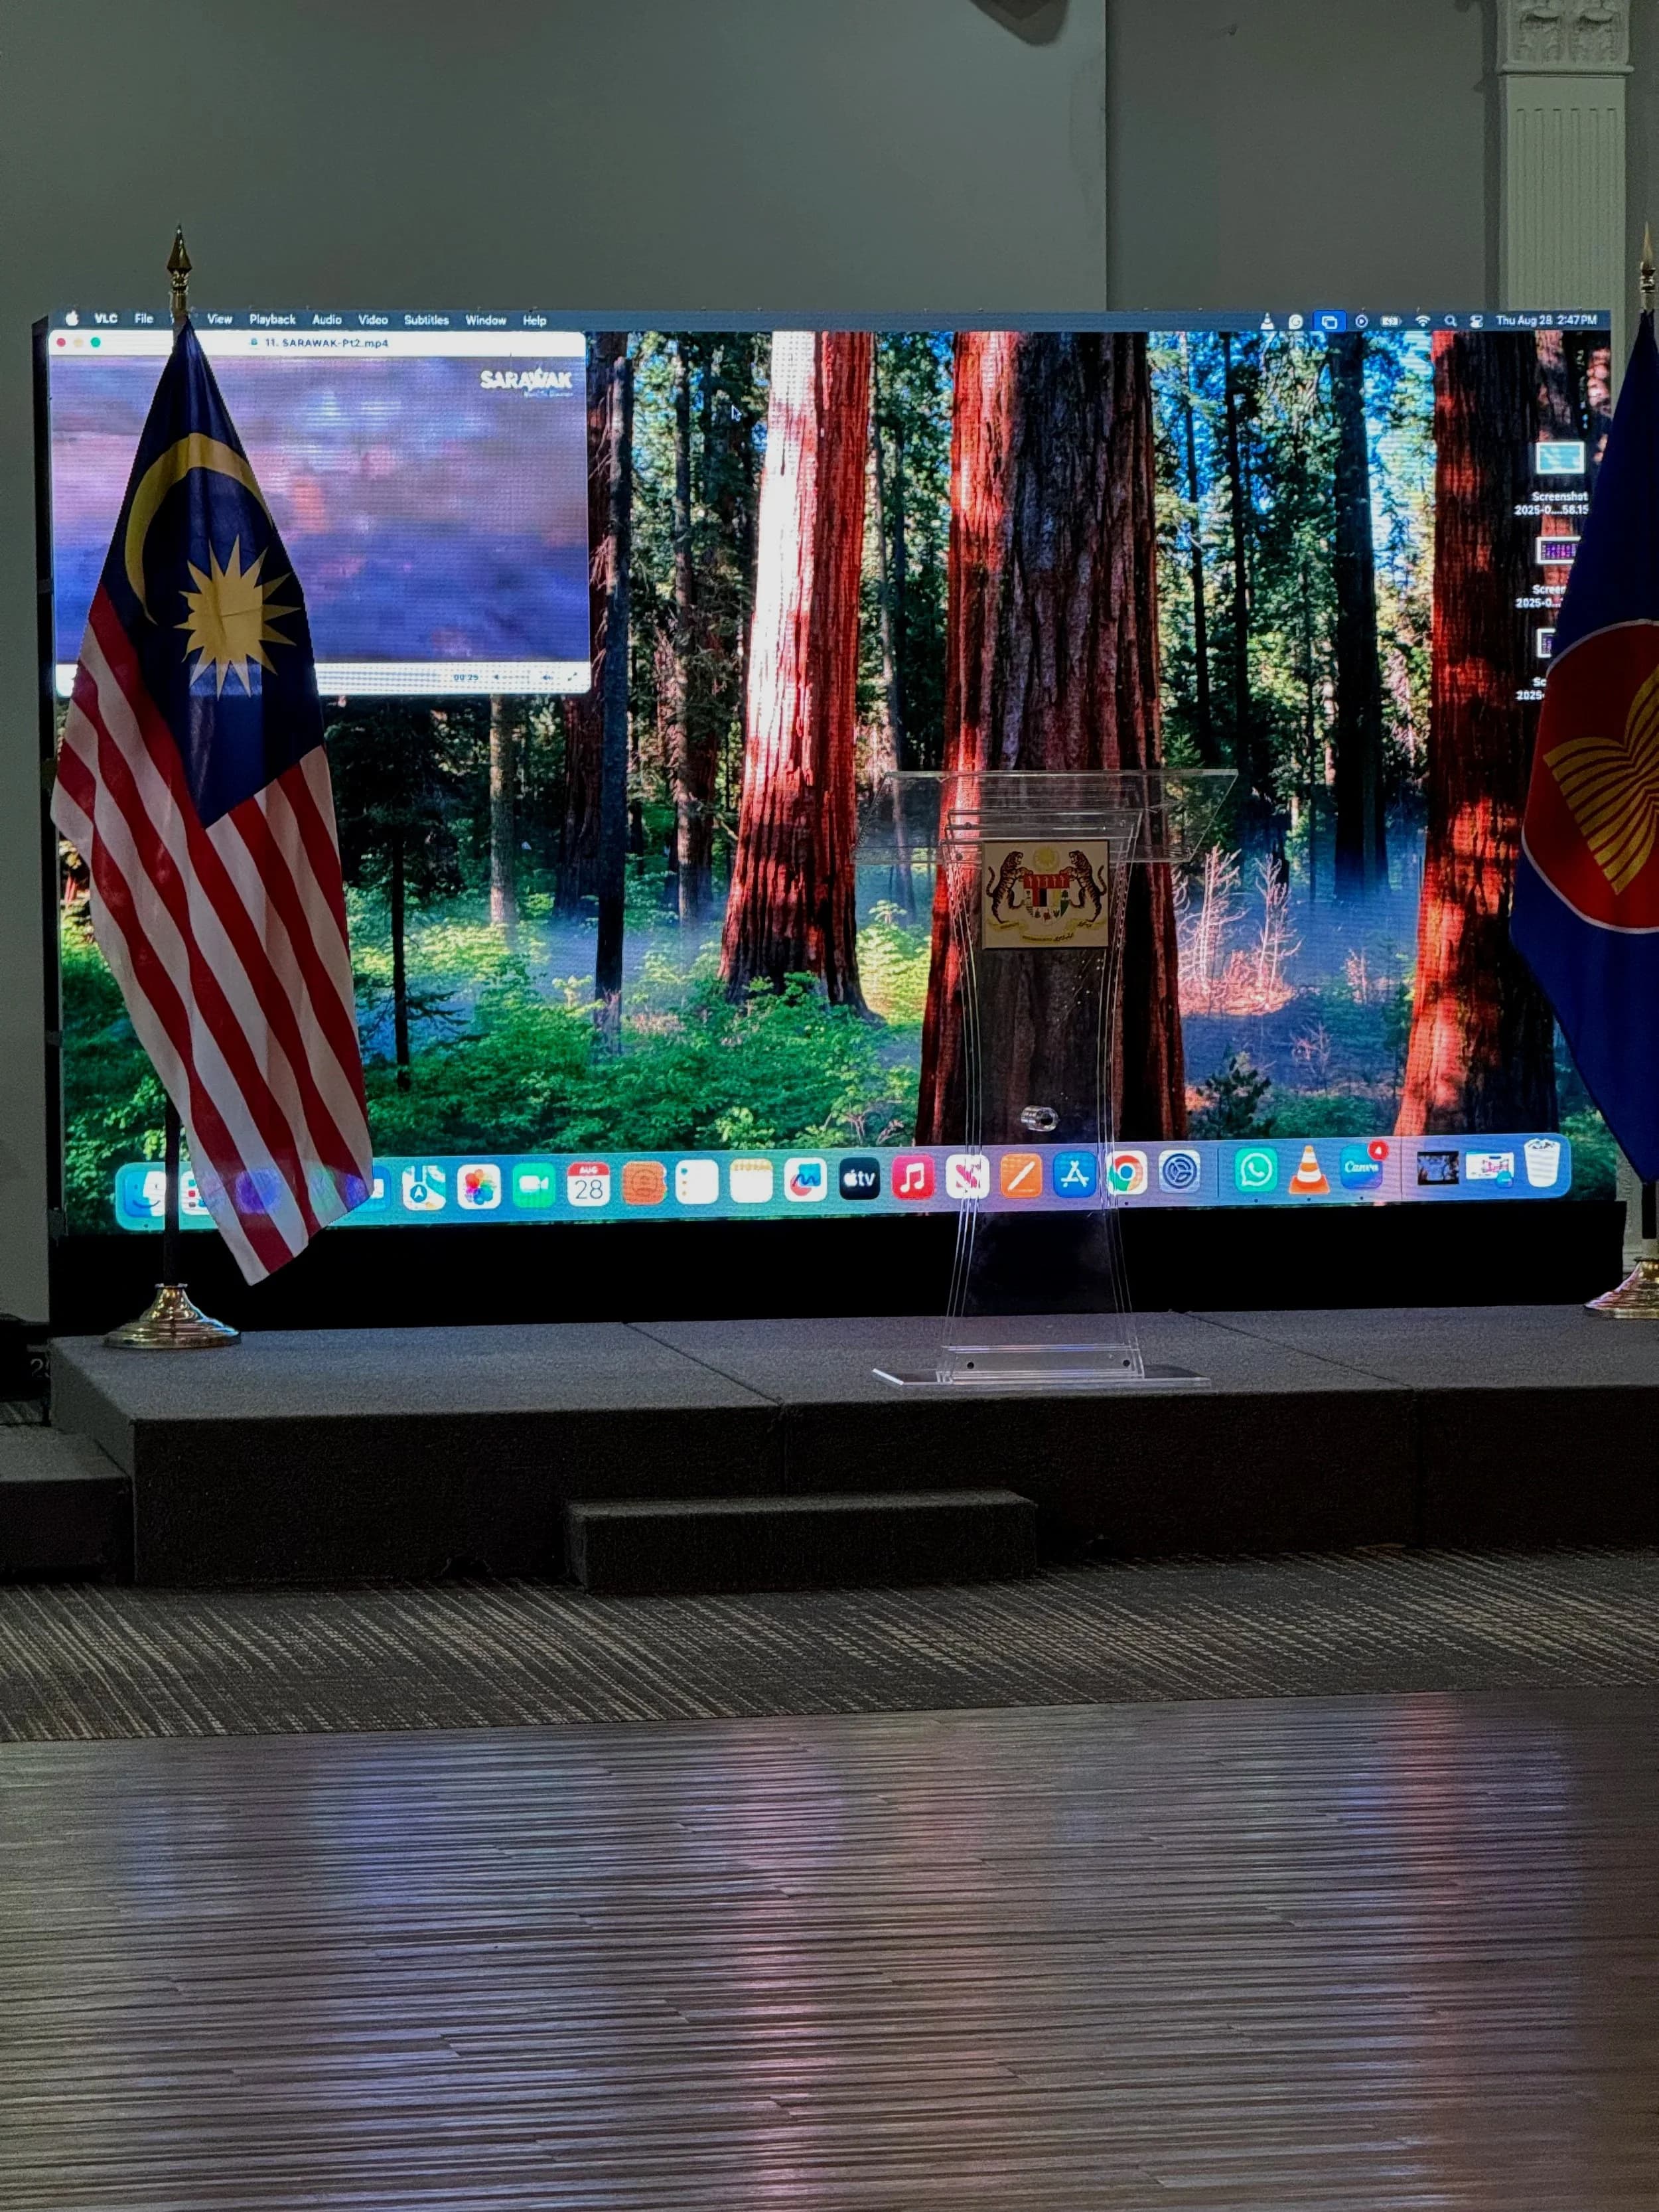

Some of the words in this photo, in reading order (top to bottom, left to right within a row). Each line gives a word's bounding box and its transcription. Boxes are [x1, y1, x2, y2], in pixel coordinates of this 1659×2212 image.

[94, 313, 118, 325] VLC
[135, 313, 154, 325] File
[208, 314, 233, 325] View
[250, 314, 297, 327] Playback
[312, 314, 342, 325] Audio
[358, 314, 389, 325] Video
[404, 314, 449, 326] Subtitles
[466, 315, 506, 326] Window
[523, 315, 547, 327] Help
[1496, 315, 1515, 325] Thu
[1518, 315, 1538, 327] Aug
[1539, 315, 1553, 325] 28
[265, 338, 279, 347] 11.
[282, 338, 389, 349] SARAWAK-Pt2.mp4
[480, 367, 573, 392] SARAWAK
[1532, 491, 1588, 502] Screenshot
[579, 1165, 599, 1174] AUG
[1344, 1160, 1379, 1173] Canva
[857, 1170, 875, 1187] tv
[575, 1179, 603, 1199] 28
